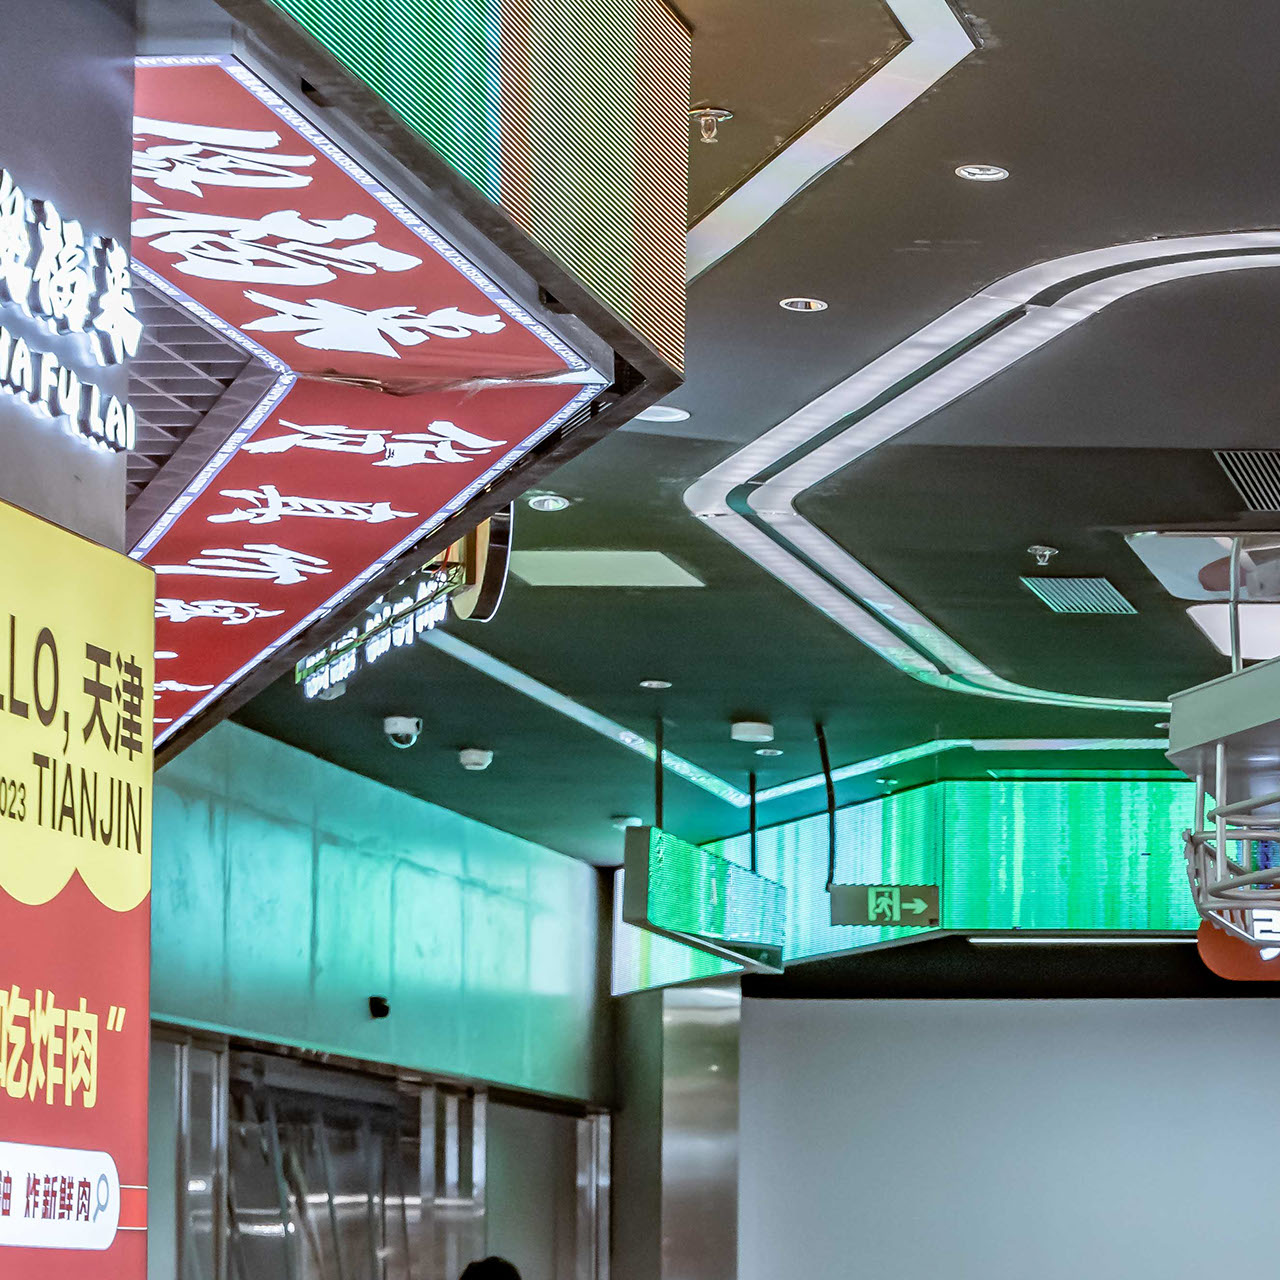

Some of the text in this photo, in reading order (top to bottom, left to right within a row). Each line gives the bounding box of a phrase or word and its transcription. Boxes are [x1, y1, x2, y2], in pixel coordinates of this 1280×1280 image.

[0, 614, 70, 756] LO,
[81, 642, 144, 762] 天津
[32, 751, 143, 855] TIANJIN
